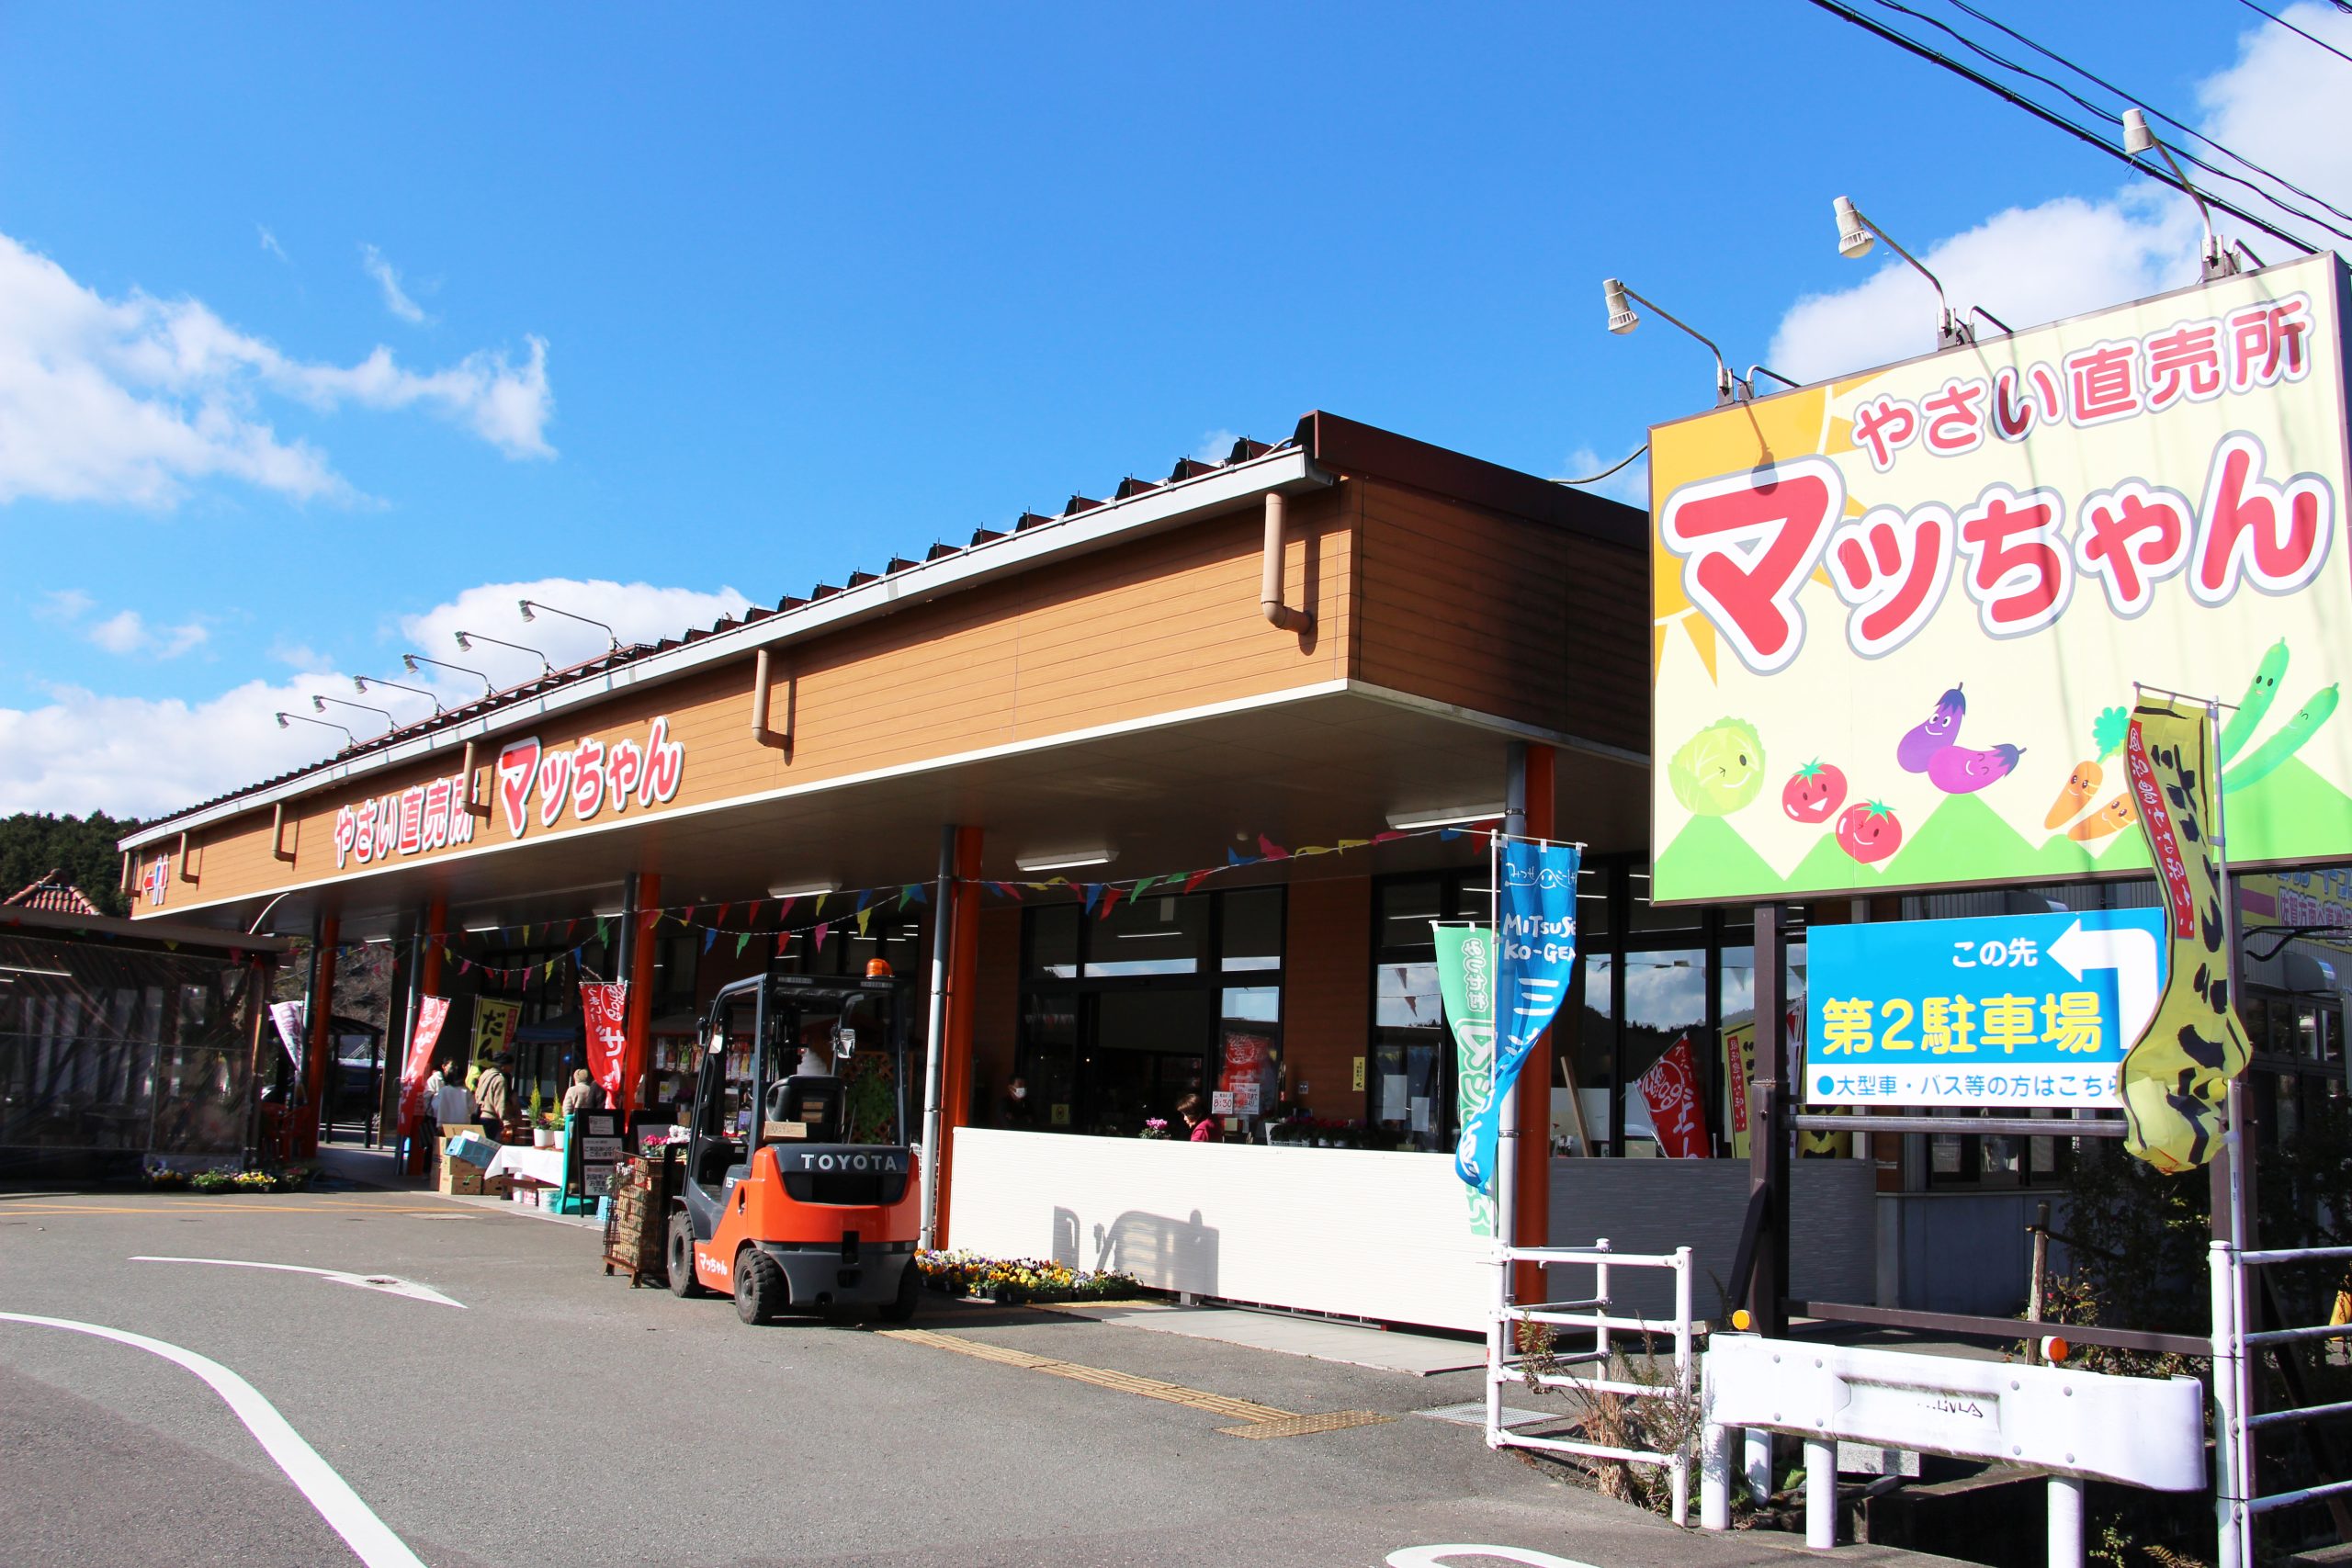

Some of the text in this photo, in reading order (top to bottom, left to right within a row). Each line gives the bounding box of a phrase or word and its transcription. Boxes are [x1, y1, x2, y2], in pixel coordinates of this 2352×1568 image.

[1854, 296, 2312, 469] やさい直売所
[335, 773, 479, 868] やさい直売所
[1952, 938, 2039, 968] この先
[1822, 991, 2102, 1055] 第2駐車場
[801, 1153, 897, 1171] TOYOTA
